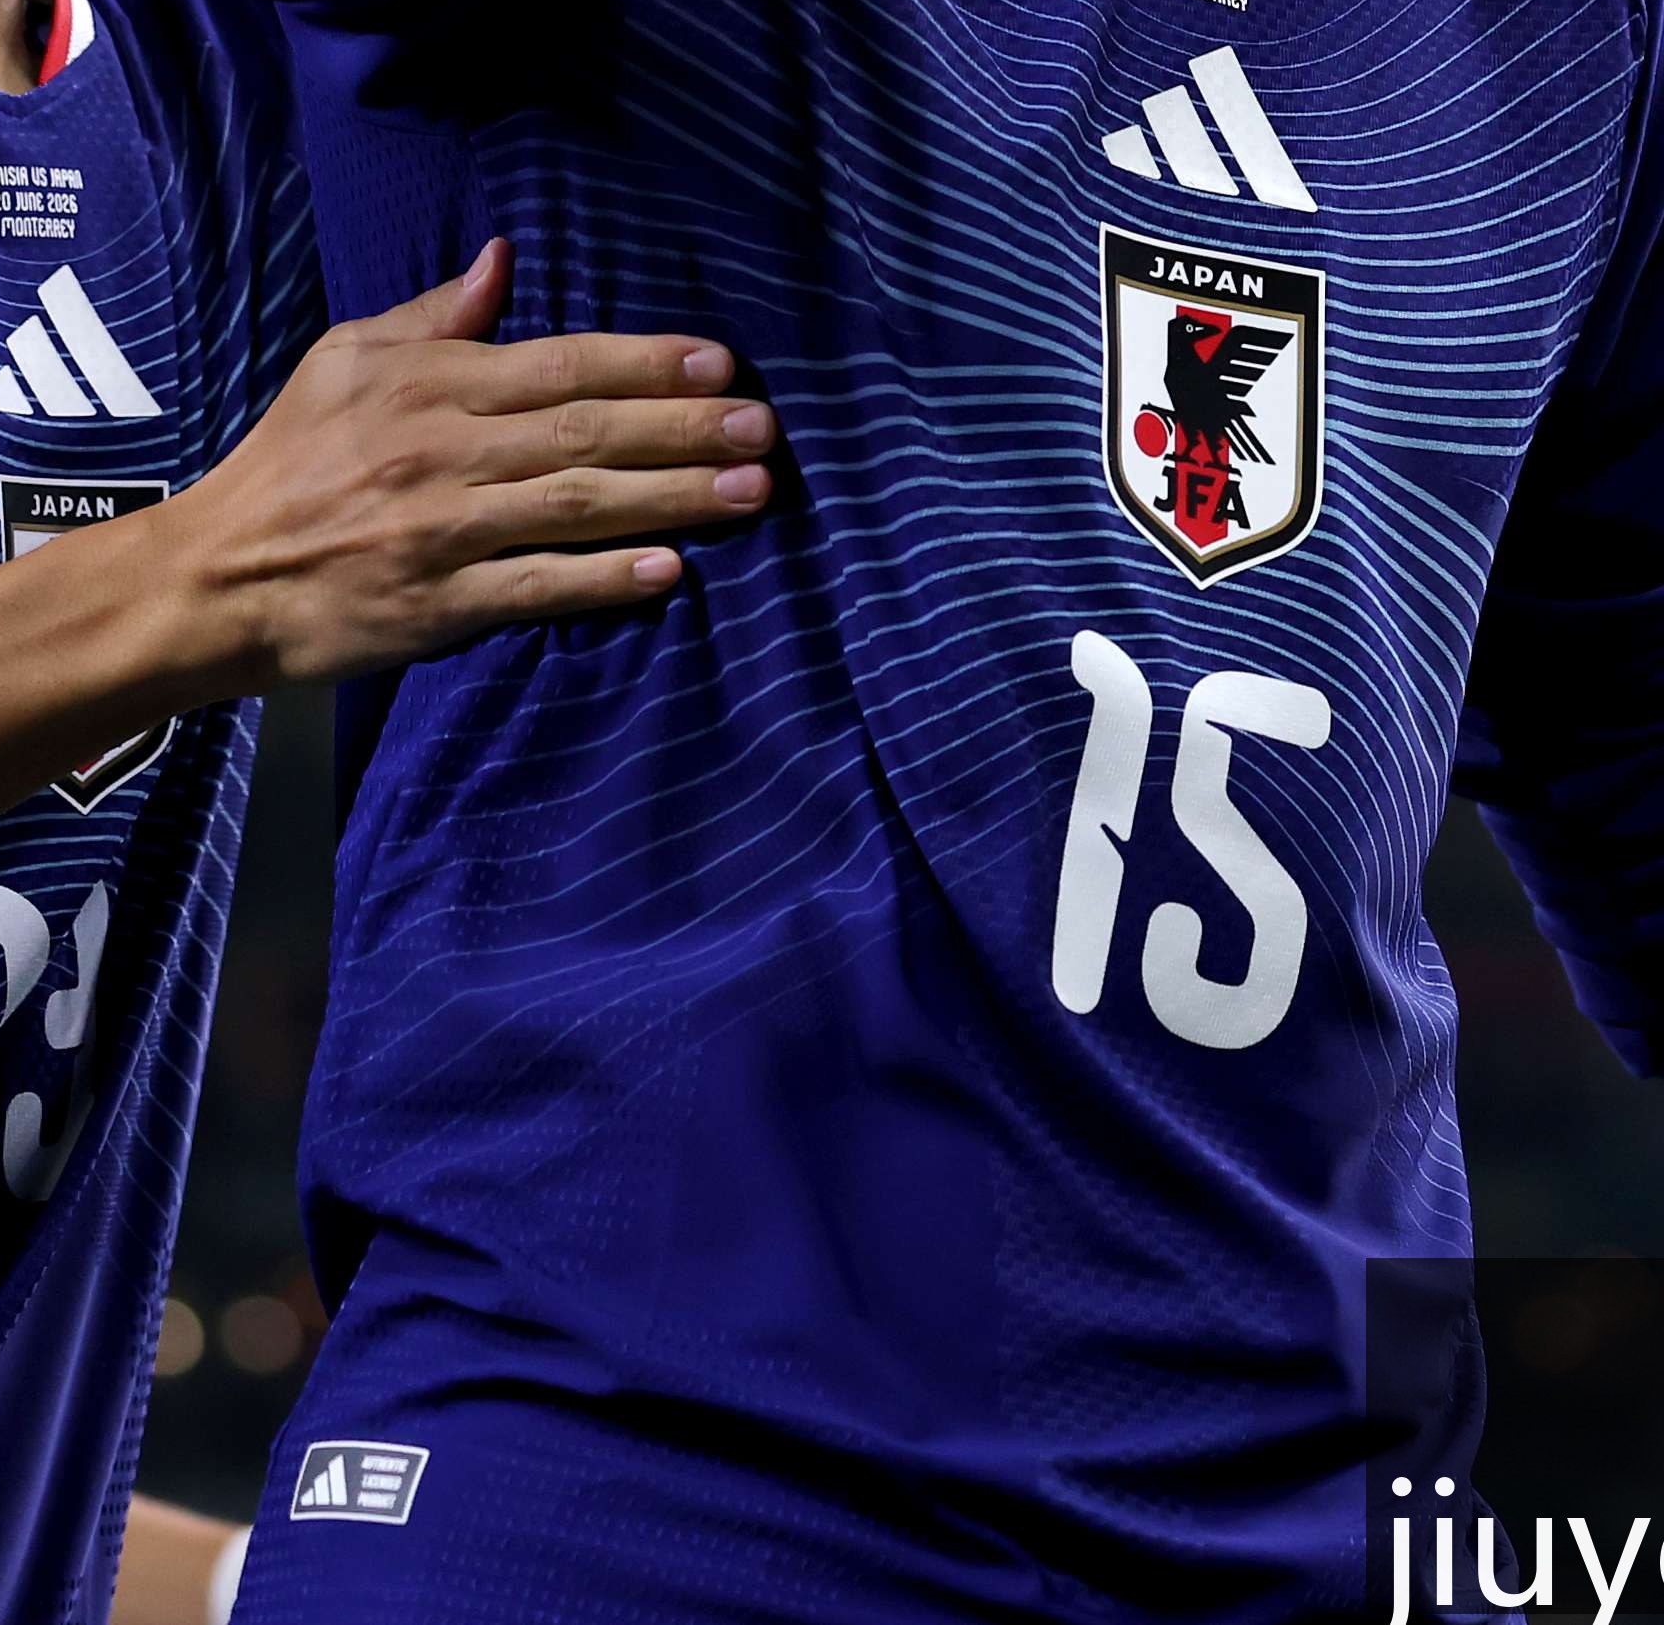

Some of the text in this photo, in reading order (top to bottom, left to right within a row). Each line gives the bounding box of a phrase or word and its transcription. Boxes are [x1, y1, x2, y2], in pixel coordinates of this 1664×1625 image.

[50, 168, 83, 190] JAPAN
[15, 191, 44, 212] JUNE
[47, 193, 78, 214] 2026
[1, 217, 75, 238] MONTERREY
[1149, 256, 1264, 299] JAPAN
[31, 494, 114, 518] JAPAN
[1153, 466, 1250, 530] JFA
[1052, 629, 1332, 1050] 15
